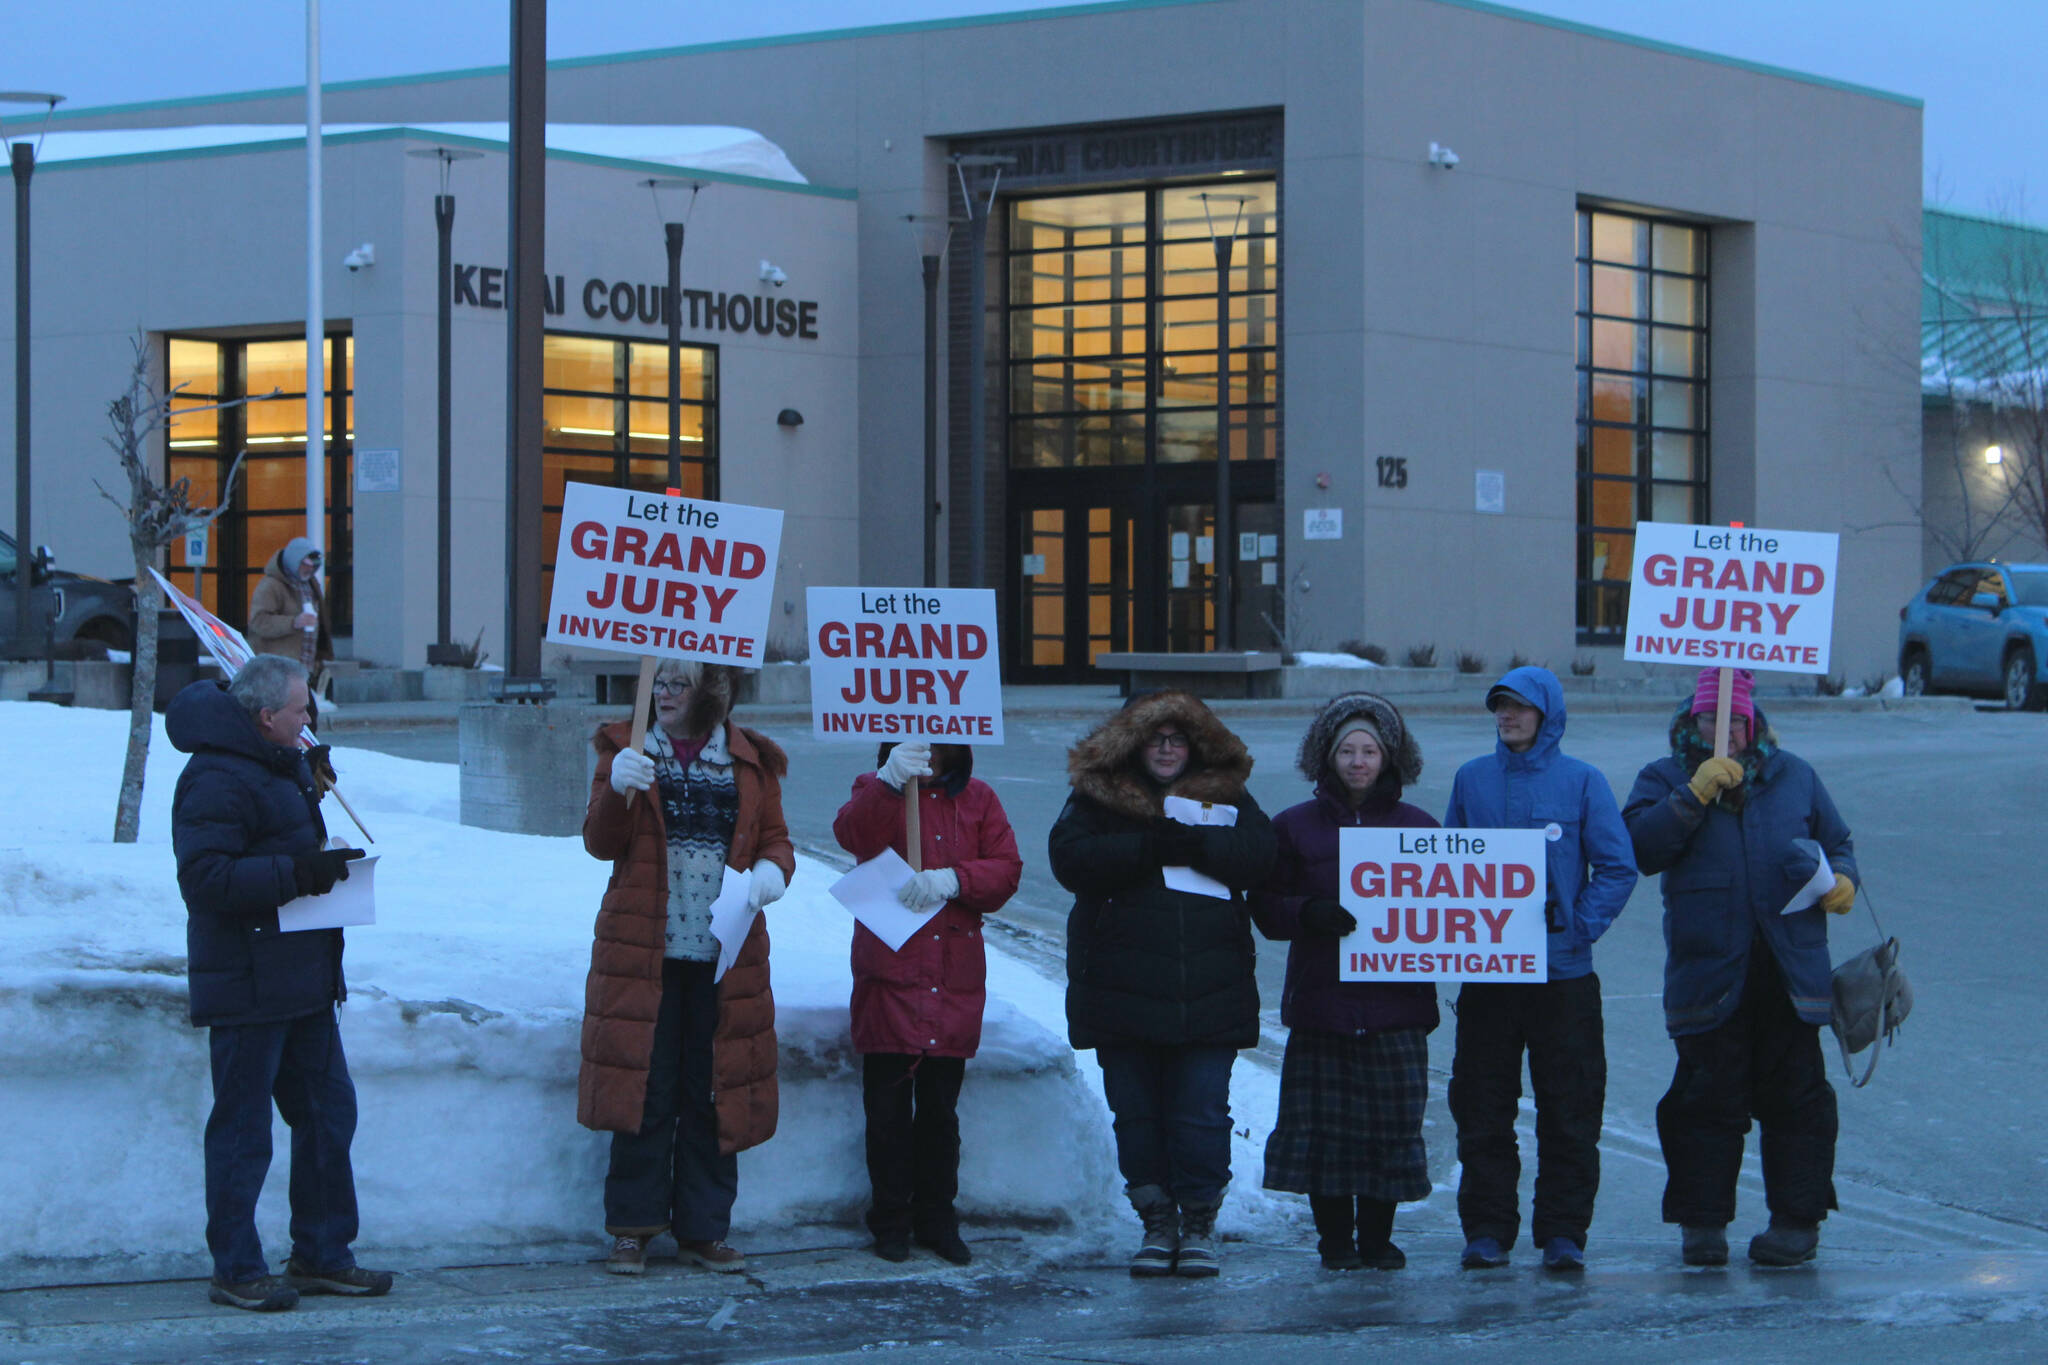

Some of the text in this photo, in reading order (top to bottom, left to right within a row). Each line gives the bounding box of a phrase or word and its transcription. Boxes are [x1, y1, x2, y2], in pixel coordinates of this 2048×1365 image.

[454, 263, 565, 315] KEAI
[1376, 456, 1408, 489] 125
[627, 495, 719, 529] Let the
[570, 520, 766, 580] GRAND
[1693, 529, 1779, 553] Let the
[1643, 554, 1825, 596] GRAND
[586, 572, 739, 624] JURY
[861, 592, 941, 615] Let the
[1660, 596, 1800, 636] JURY
[558, 613, 754, 658] INVESTIGATE
[818, 621, 988, 660] GRAND
[1635, 635, 1819, 665] INVESTIGATE
[841, 668, 969, 705] JURY
[823, 712, 993, 736] INVESTIGATE
[1399, 833, 1486, 854] Let the
[1350, 861, 1536, 899] GRAND
[1372, 908, 1513, 944] JURY
[1350, 953, 1536, 974] INVESTIGATE
